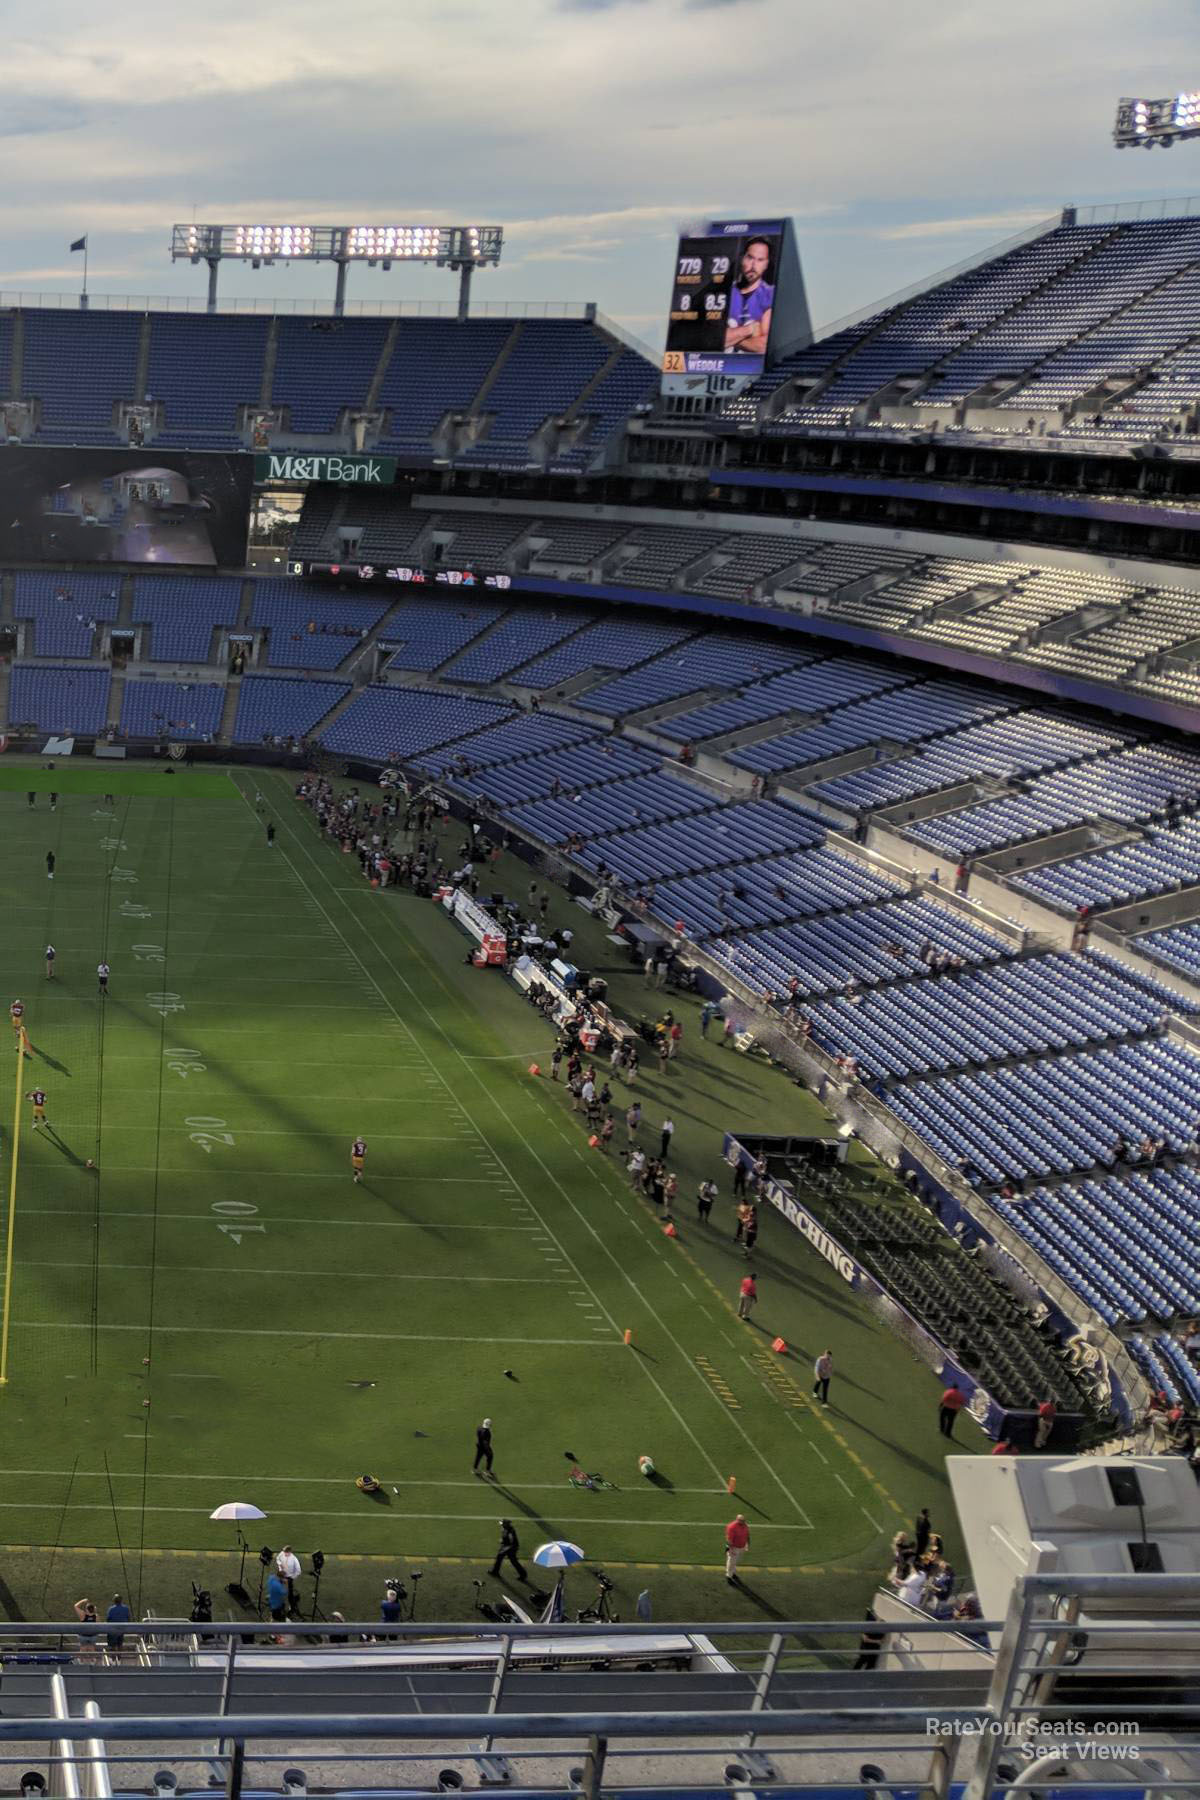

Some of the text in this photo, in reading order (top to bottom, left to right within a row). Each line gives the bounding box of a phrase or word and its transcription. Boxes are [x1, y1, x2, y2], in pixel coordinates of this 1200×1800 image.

[679, 257, 702, 275] 779
[711, 257, 729, 274] 29
[680, 294, 691, 311] 8
[705, 294, 726, 310] 8.5
[666, 354, 680, 370] 32
[688, 360, 725, 371] WEDDLE
[705, 375, 736, 394] Lite
[268, 456, 381, 482] M&T Bank
[163, 1048, 207, 1072] 30
[184, 1116, 236, 1147] 20
[210, 1201, 267, 1234] 10
